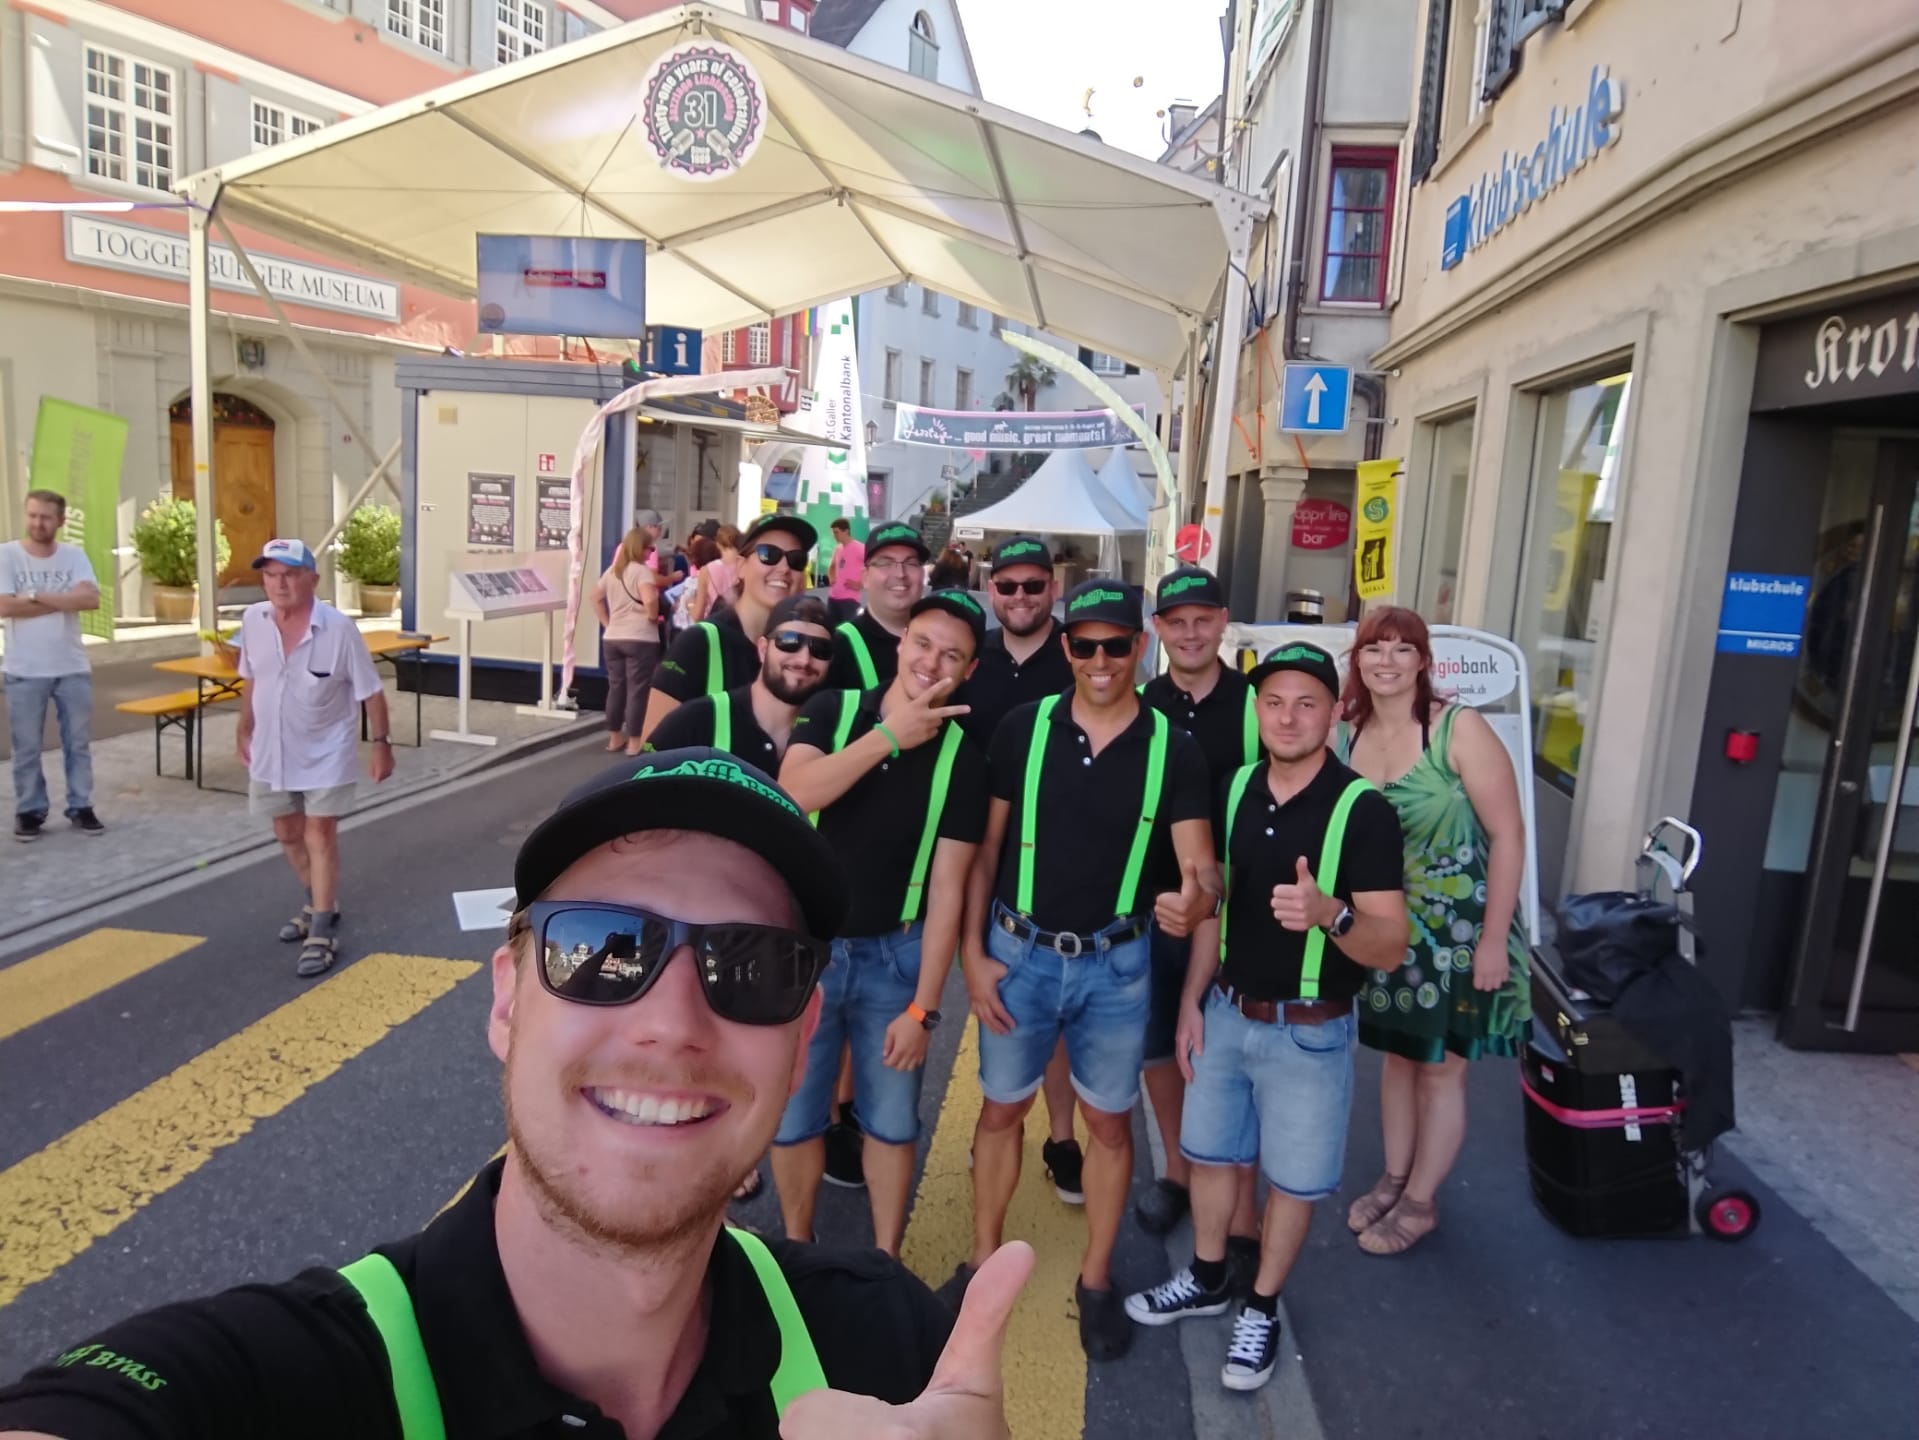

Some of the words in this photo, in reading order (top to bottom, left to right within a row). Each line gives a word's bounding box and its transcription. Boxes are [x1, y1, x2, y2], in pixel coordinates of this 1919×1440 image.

[674, 60, 708, 81] years
[711, 61, 726, 76] of
[723, 69, 749, 144] celebration
[685, 91, 717, 127] 31
[1467, 64, 1618, 251] klubschule
[89, 227, 293, 291] TOGGEBURGER
[300, 273, 385, 310] MUSEUM
[840, 355, 851, 441] Kantonalbank
[1023, 431, 1052, 445] great
[1302, 533, 1327, 544] bar
[1730, 577, 1804, 596] klubschule
